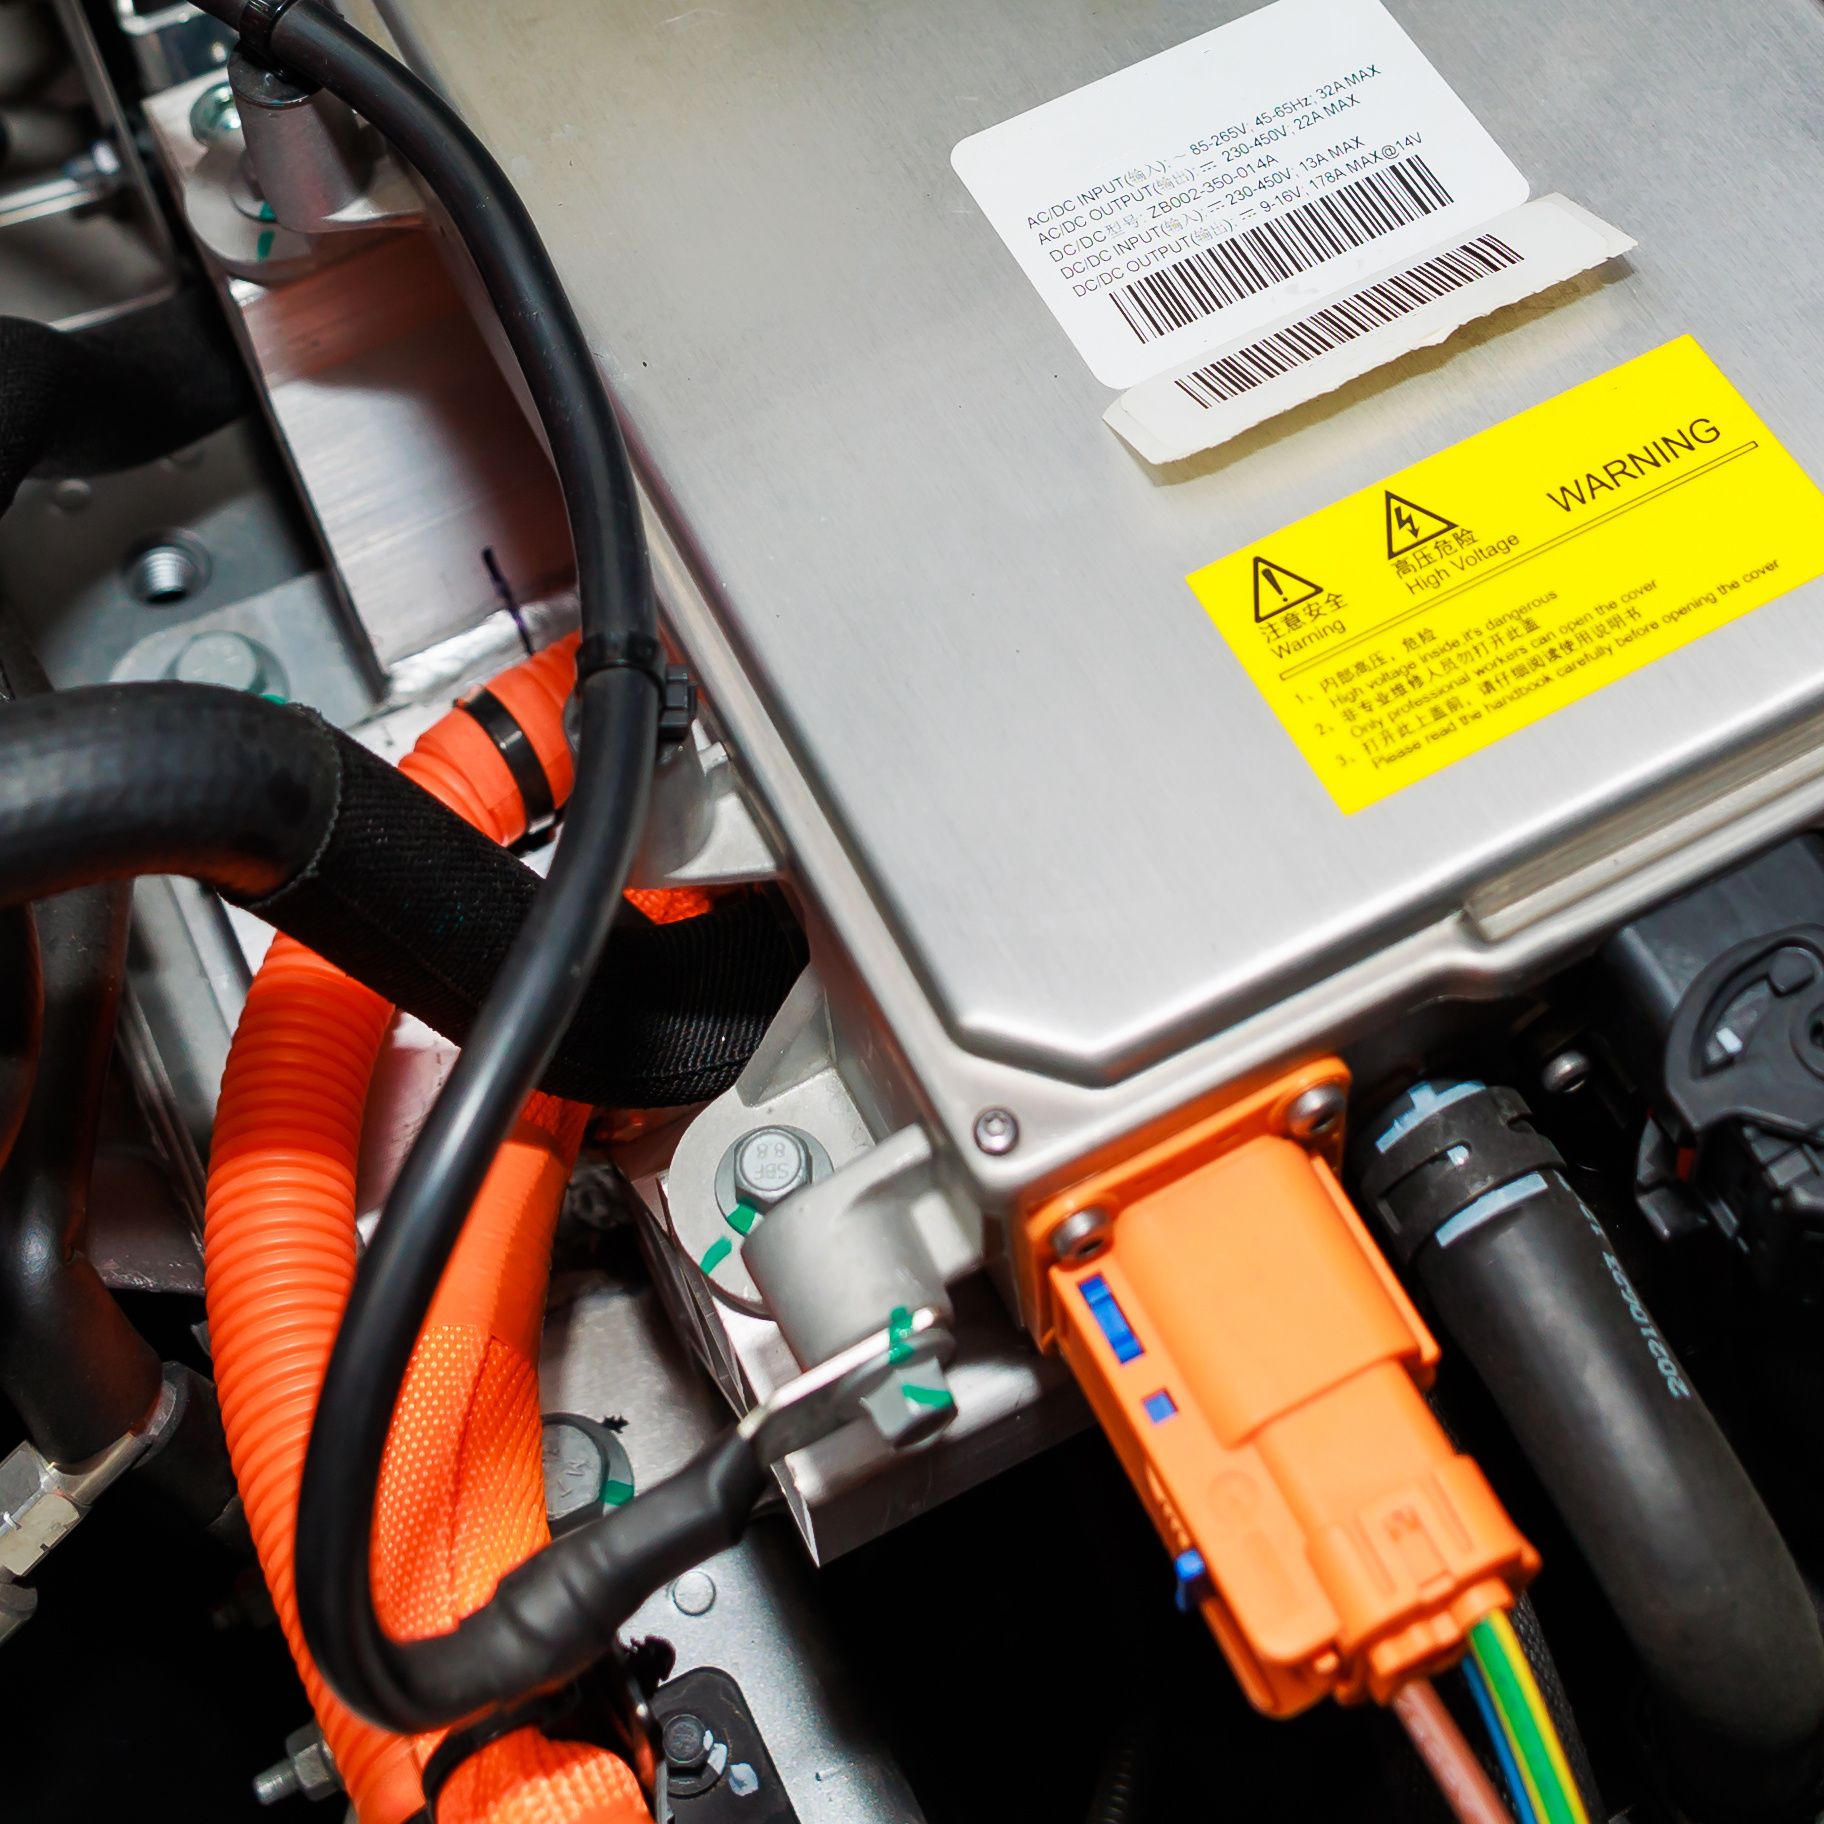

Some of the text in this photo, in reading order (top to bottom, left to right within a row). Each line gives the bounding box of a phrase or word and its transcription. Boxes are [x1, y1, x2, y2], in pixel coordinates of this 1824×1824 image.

[1028, 200, 1075, 229] AC/DC
[1316, 81, 1346, 99] 32A
[1344, 65, 1381, 87] MAX
[1039, 216, 1087, 245] AC/DC
[1294, 111, 1324, 130] 22A
[1323, 94, 1360, 116] MAX
[1146, 155, 1279, 218] ZB002-350-014A
[1060, 250, 1111, 279] DC/DC
[1299, 154, 1328, 171] 13A
[1328, 136, 1365, 159] MAX
[1072, 267, 1124, 297] DC/DC
[1310, 168, 1347, 189] 178A
[1346, 132, 1421, 173] MAX@14V
[1546, 418, 1720, 512] WARNING
[1391, 528, 1478, 579] 高压危险
[1405, 535, 1519, 595] High Voltage
[1260, 593, 1347, 644] 注意安全
[1271, 620, 1346, 659] Warning
[1329, 687, 1364, 708] High
[1366, 661, 1417, 690] voltage
[1486, 591, 1558, 631] dangerous
[1350, 580, 1657, 738] Only professional workers can open the cover
[1372, 560, 1779, 769] Please read the handbook carefully before opening the cover
